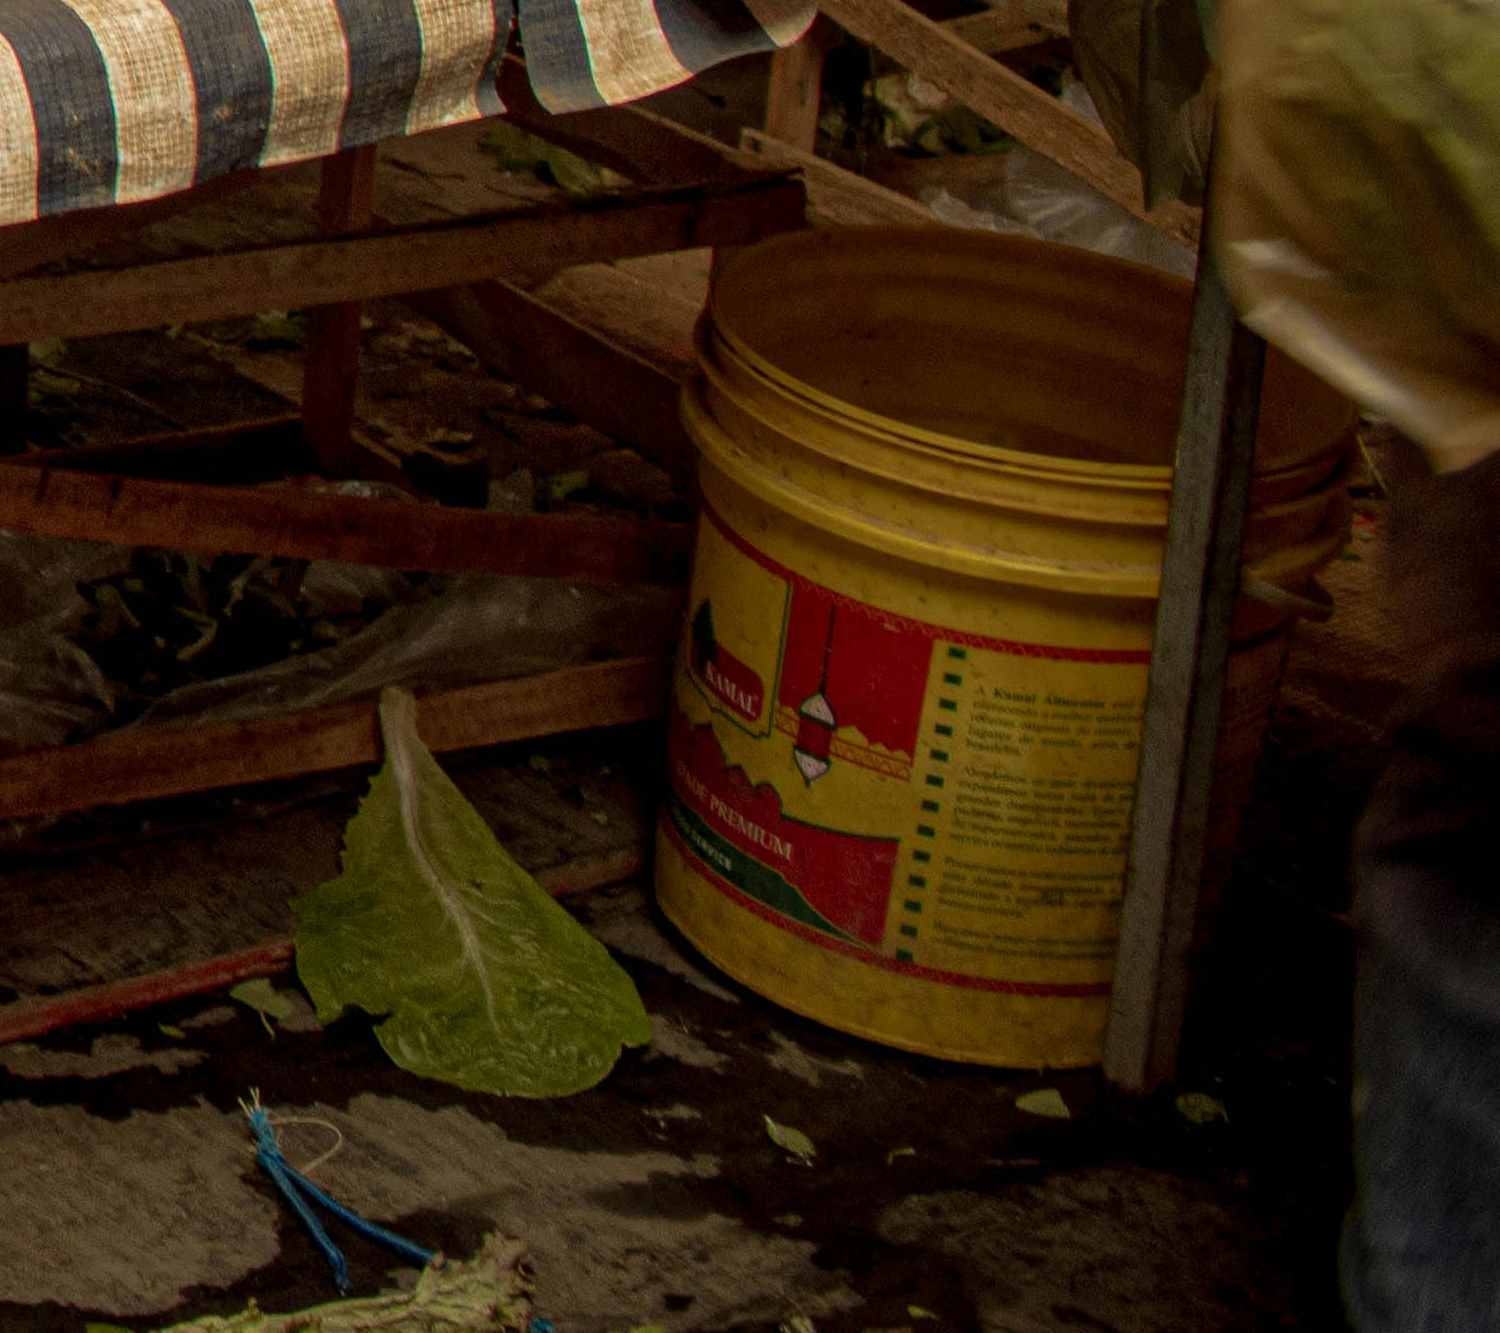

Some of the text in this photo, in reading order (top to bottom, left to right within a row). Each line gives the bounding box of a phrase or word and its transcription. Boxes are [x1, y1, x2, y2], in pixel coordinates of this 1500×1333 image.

[705, 659, 756, 716] KAMAL
[994, 688, 1037, 703] Kamal
[691, 829, 733, 872] SERVICE
[709, 792, 794, 862] PREMIUM
